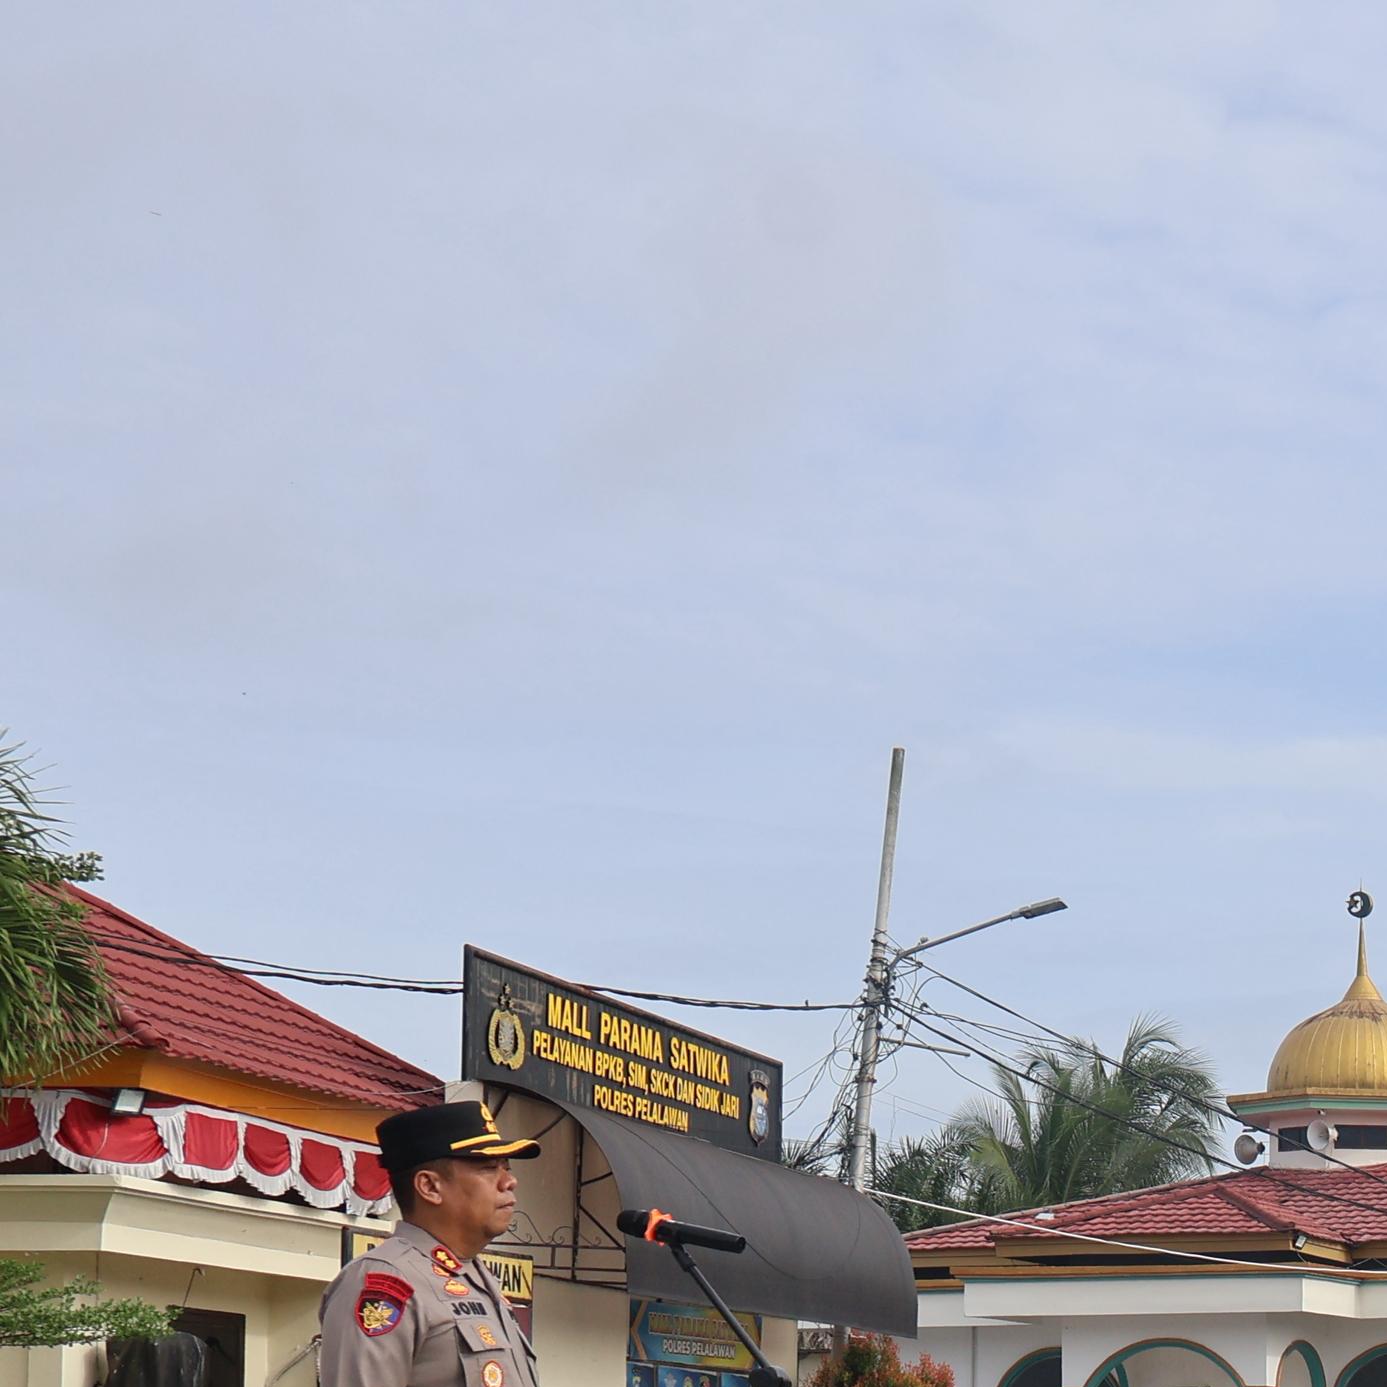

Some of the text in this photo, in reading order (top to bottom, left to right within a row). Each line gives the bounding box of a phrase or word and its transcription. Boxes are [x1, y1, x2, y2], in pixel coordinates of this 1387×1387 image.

[533, 1028, 740, 1121] PELAYANAN BPKB, SIM, SKCK DAN SIDIK JARI
[547, 993, 730, 1087] MALL PARAMA SATWIKA
[594, 1084, 690, 1134] POLRES PELALAWAN
[662, 1339, 737, 1361] POLRES PELALAWAN
